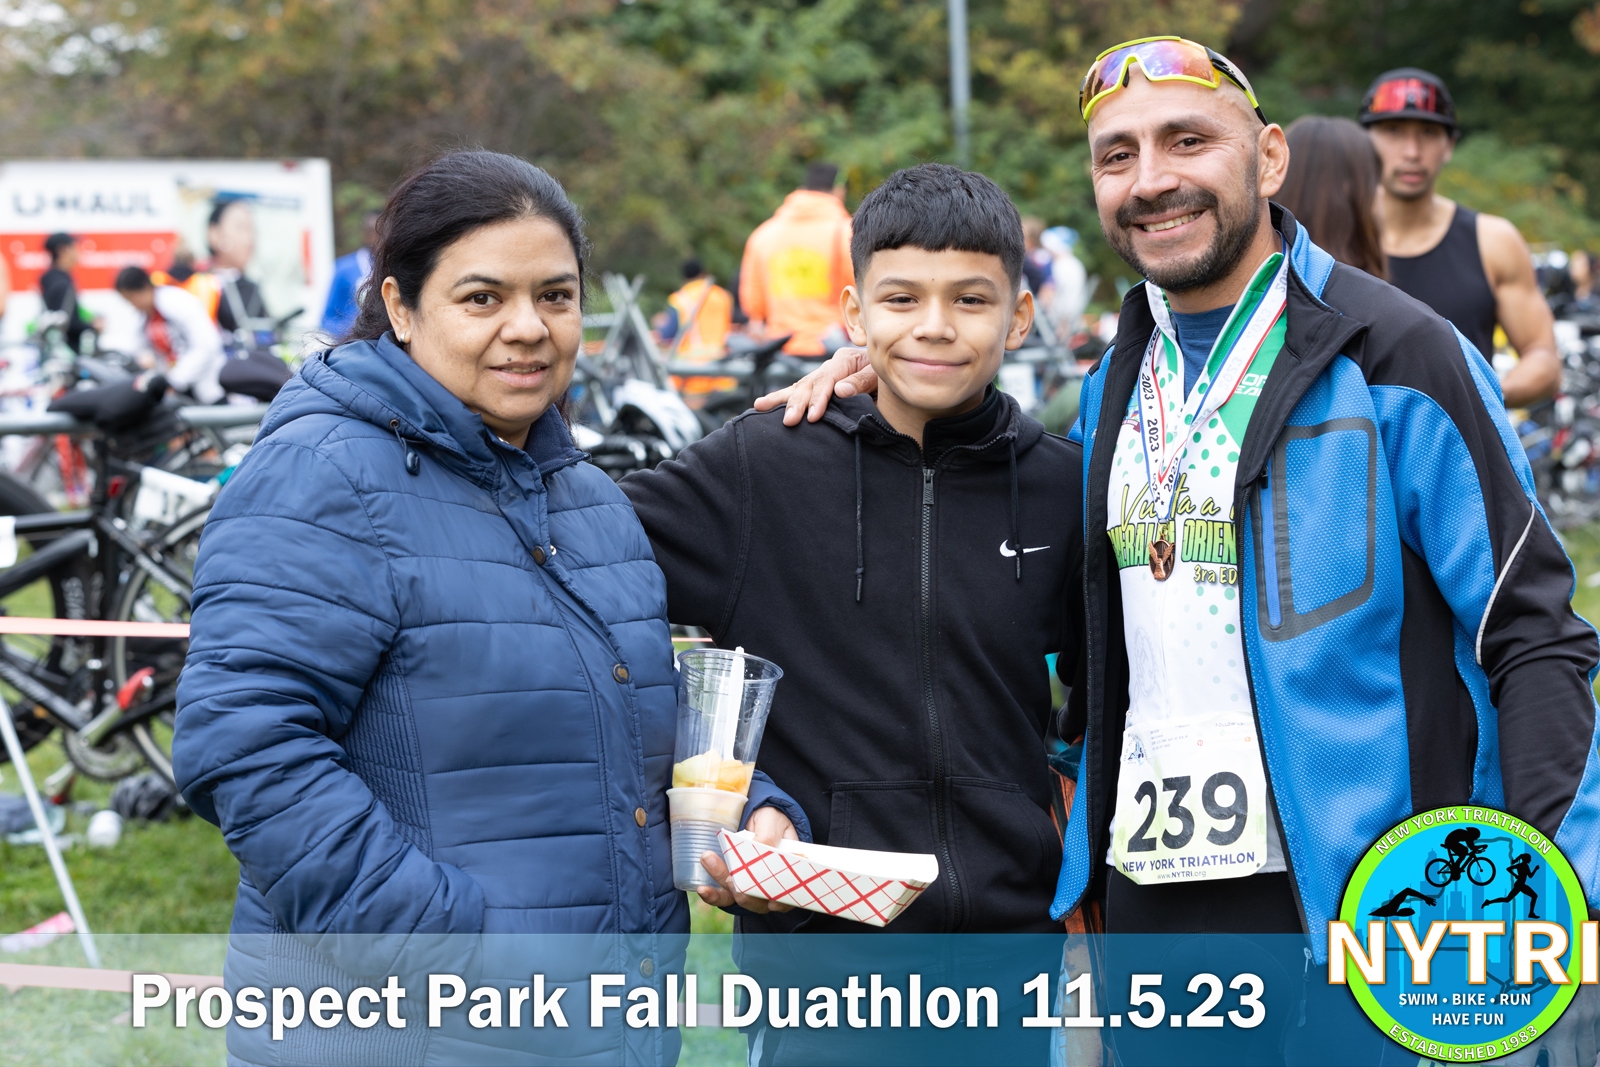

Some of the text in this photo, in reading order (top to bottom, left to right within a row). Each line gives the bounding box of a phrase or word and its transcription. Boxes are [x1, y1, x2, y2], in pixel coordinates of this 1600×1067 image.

[1141, 373, 1155, 401] 2023
[1147, 418, 1160, 452] 2023
[1193, 564, 1216, 583] 3ra
[1127, 771, 1248, 853] 239
[1122, 852, 1255, 872] NEW YORK TRIATHLON
[1157, 870, 1207, 879] www.NYTRI.org
